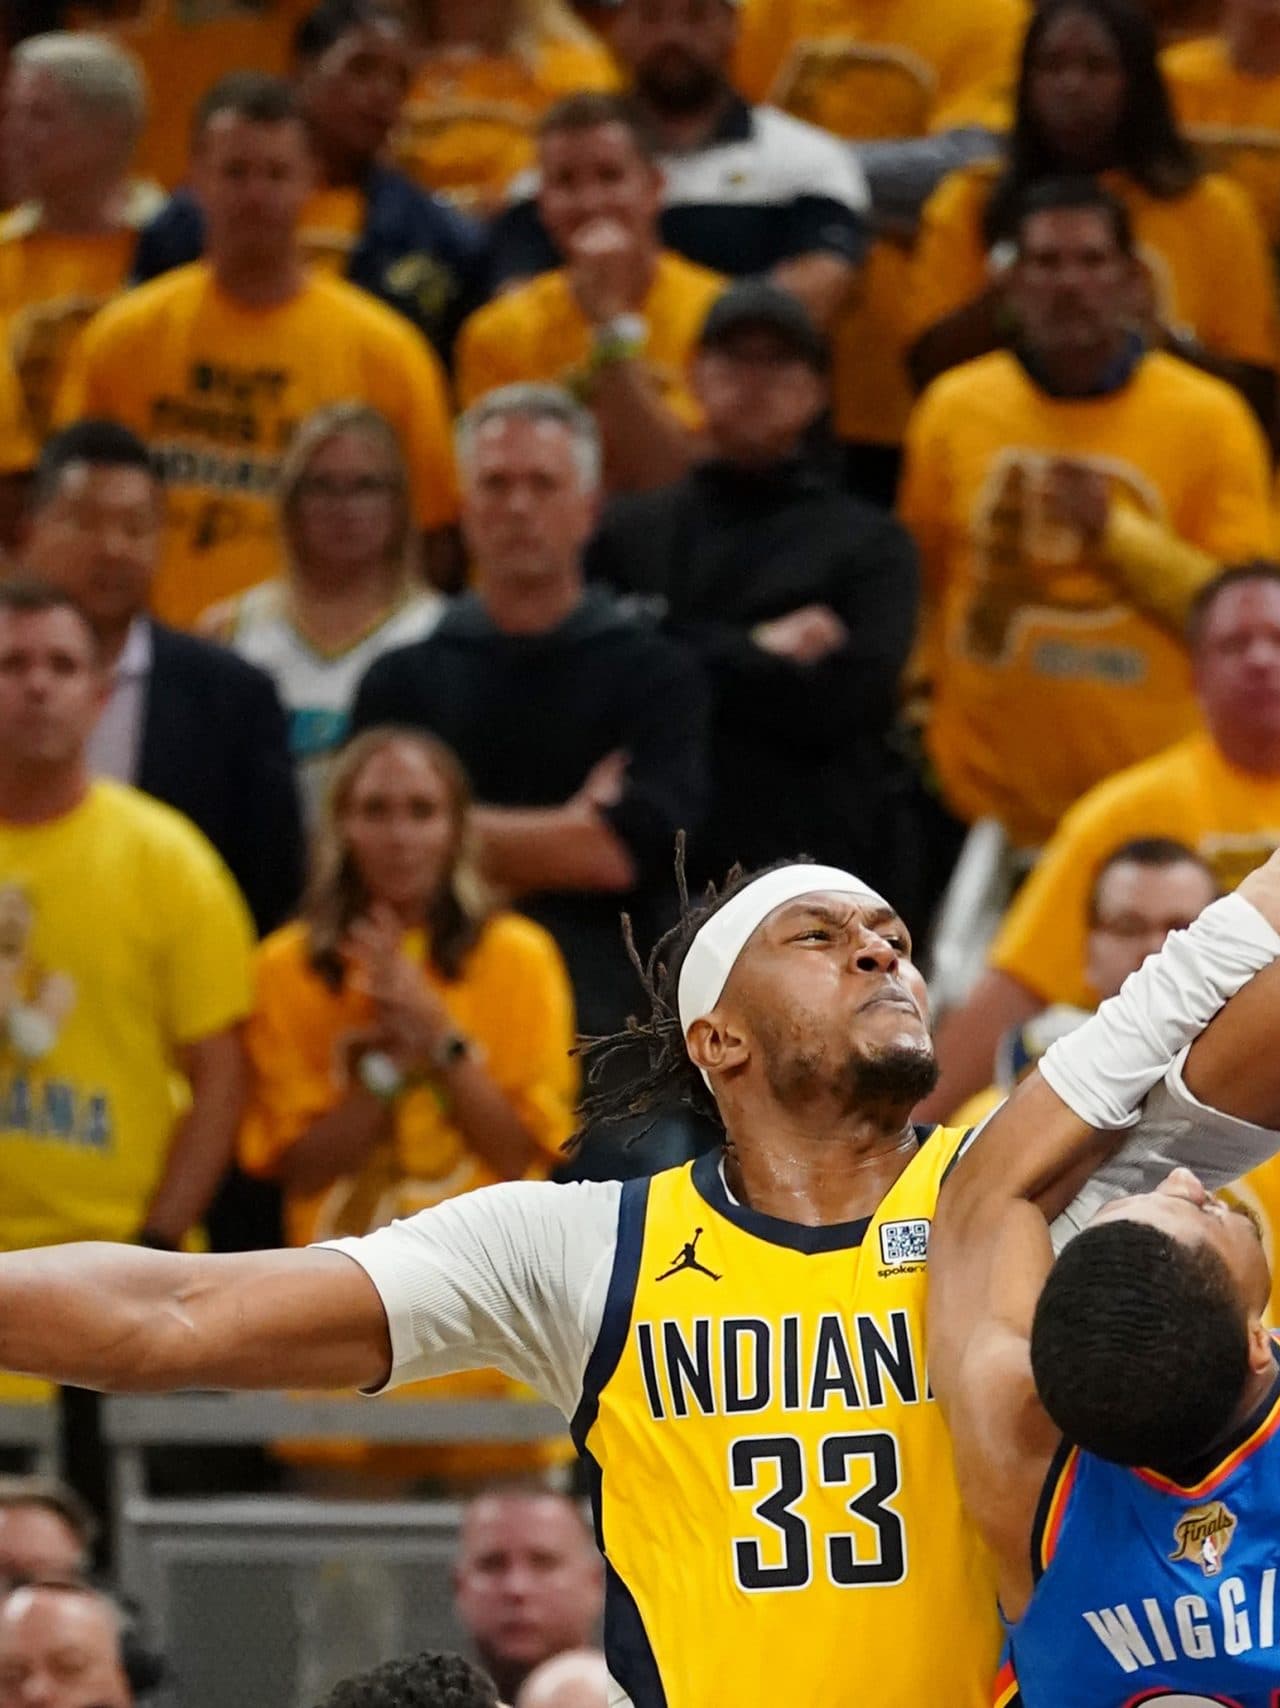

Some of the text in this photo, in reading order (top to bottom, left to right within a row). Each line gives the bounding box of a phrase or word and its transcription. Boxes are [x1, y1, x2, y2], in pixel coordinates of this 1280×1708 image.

[637, 1311, 936, 1421] INDIAN
[729, 1430, 907, 1592] 33
[1169, 1506, 1235, 1559] Finals
